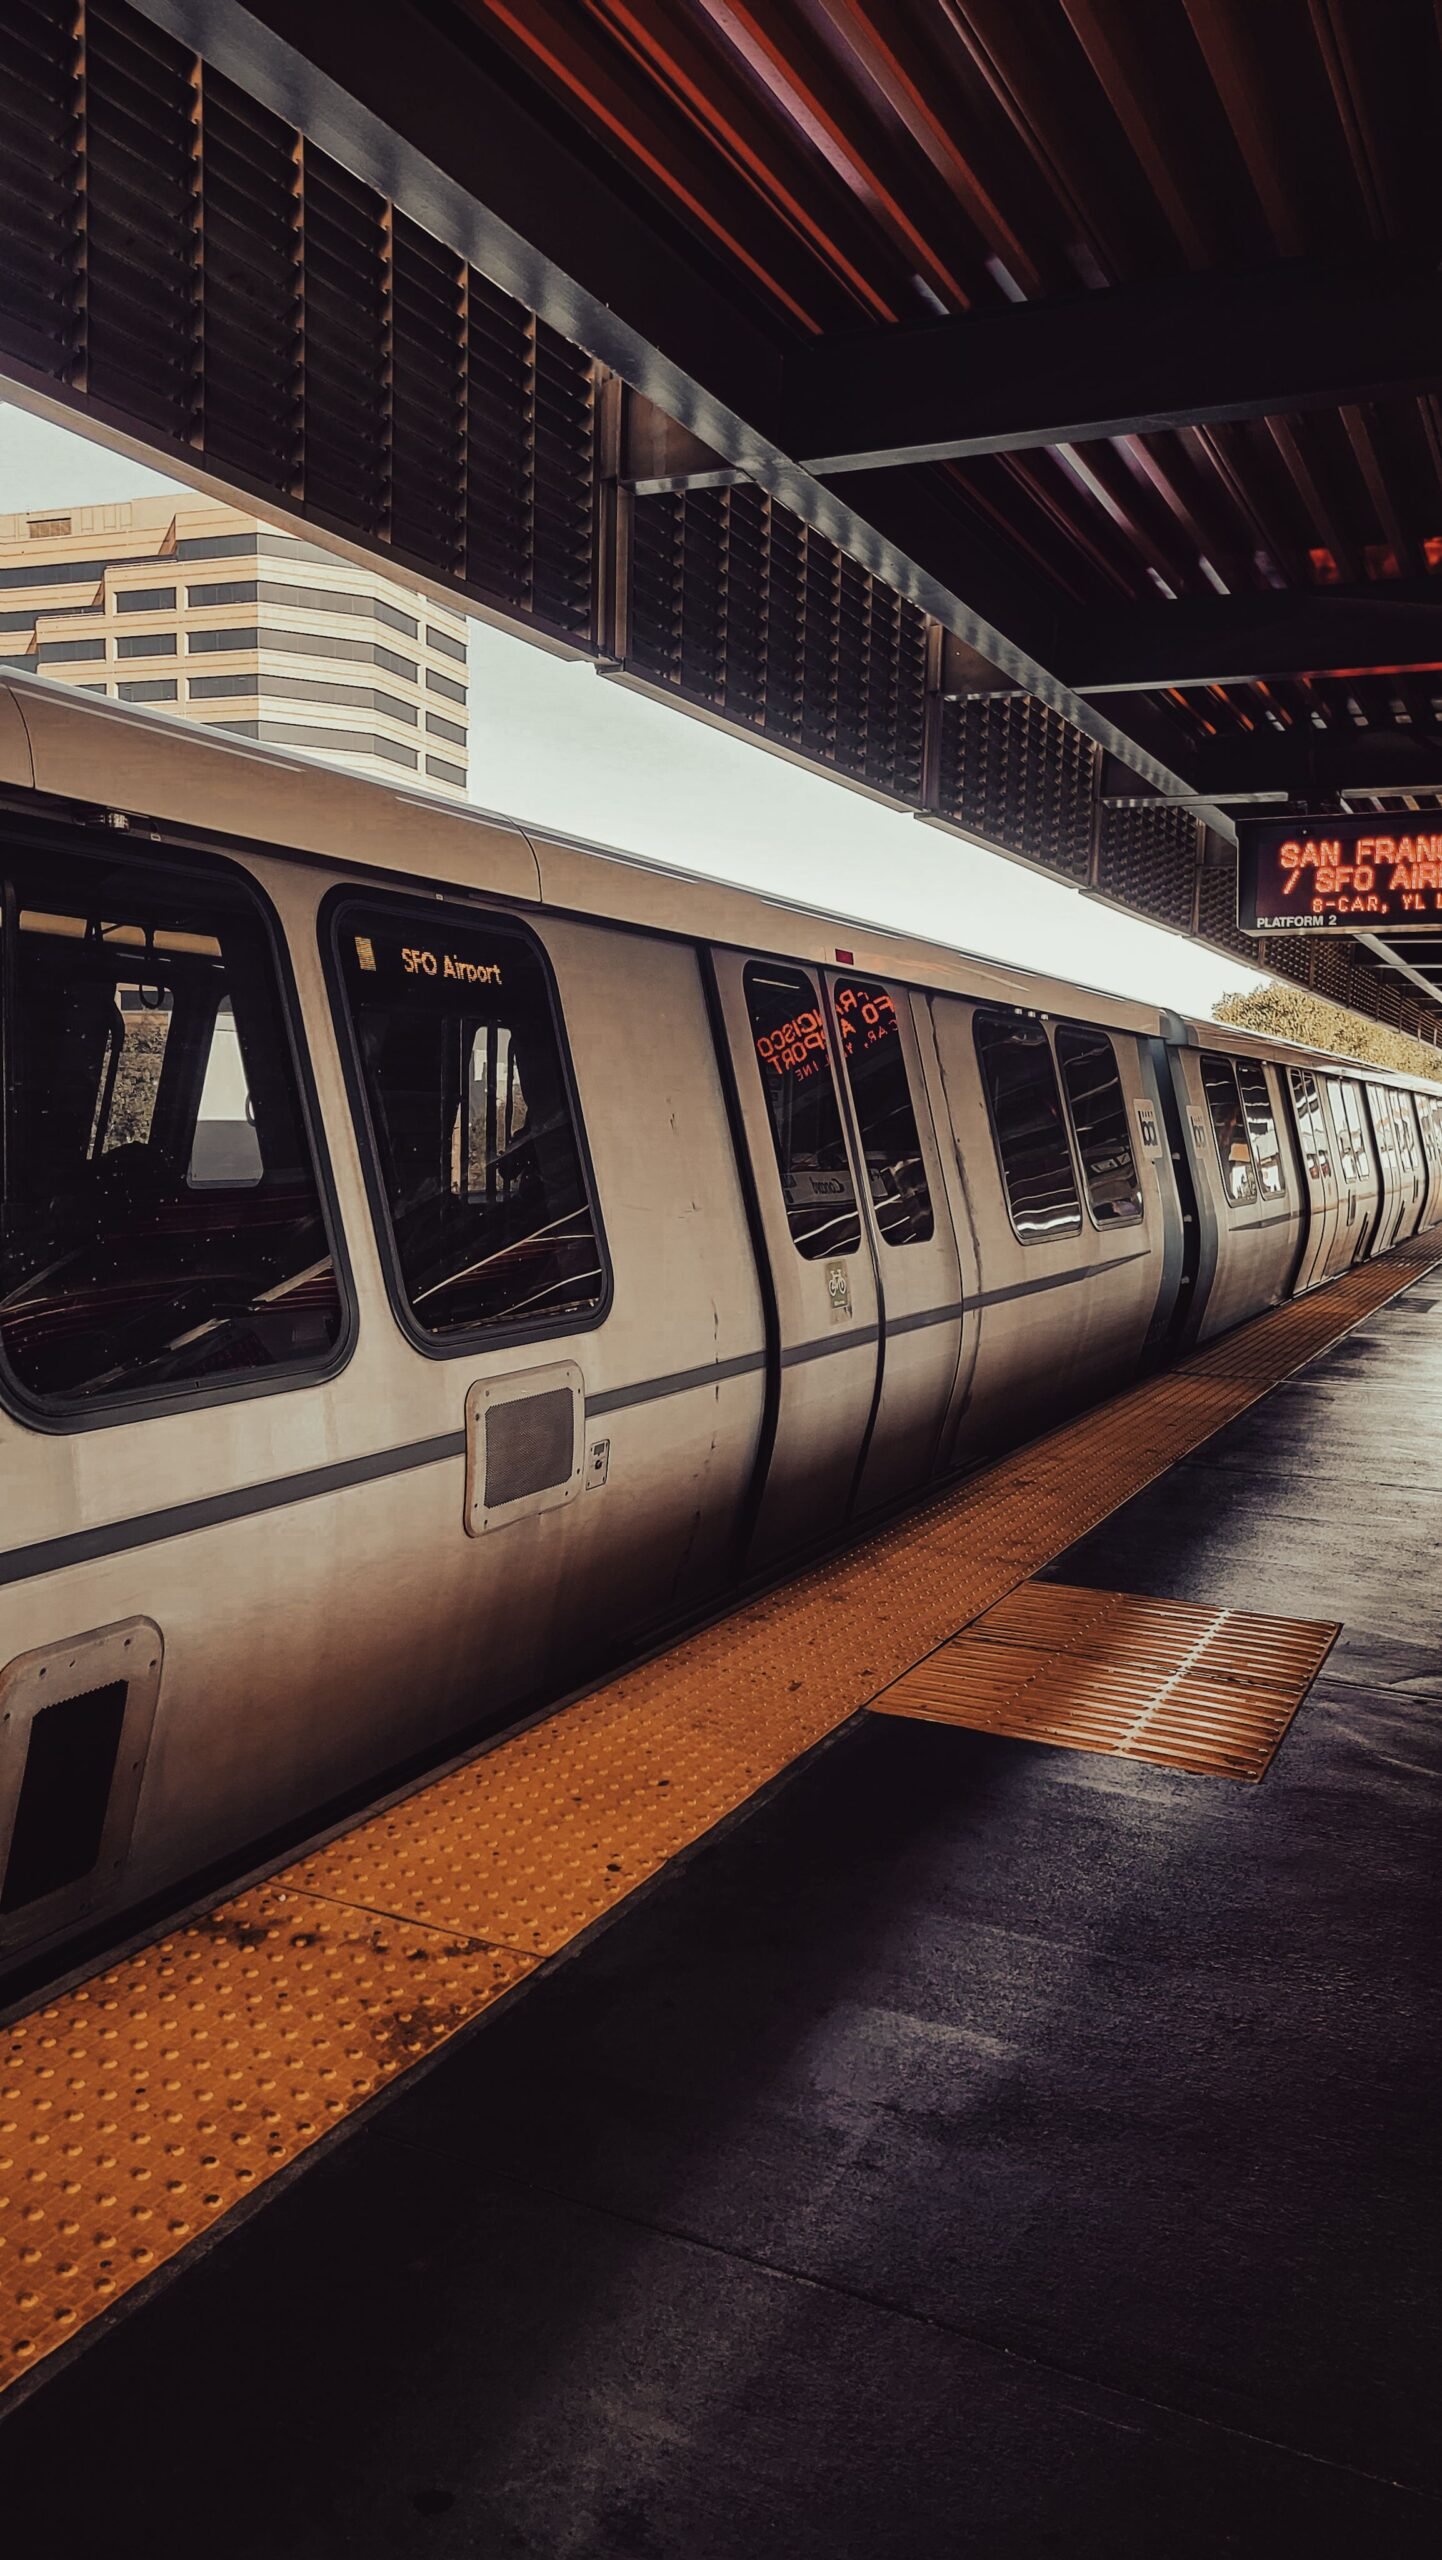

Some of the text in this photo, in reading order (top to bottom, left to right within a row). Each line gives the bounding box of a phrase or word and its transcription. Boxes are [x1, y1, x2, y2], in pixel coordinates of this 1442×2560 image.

[1280, 834, 1442, 868] SAN FRAN
[1315, 866, 1374, 892] SFO
[1312, 896, 1389, 914] 8-CAR,
[1402, 893, 1426, 910] YL
[1257, 915, 1337, 928] PLATFORM 2
[401, 948, 503, 985] SFO Airport
